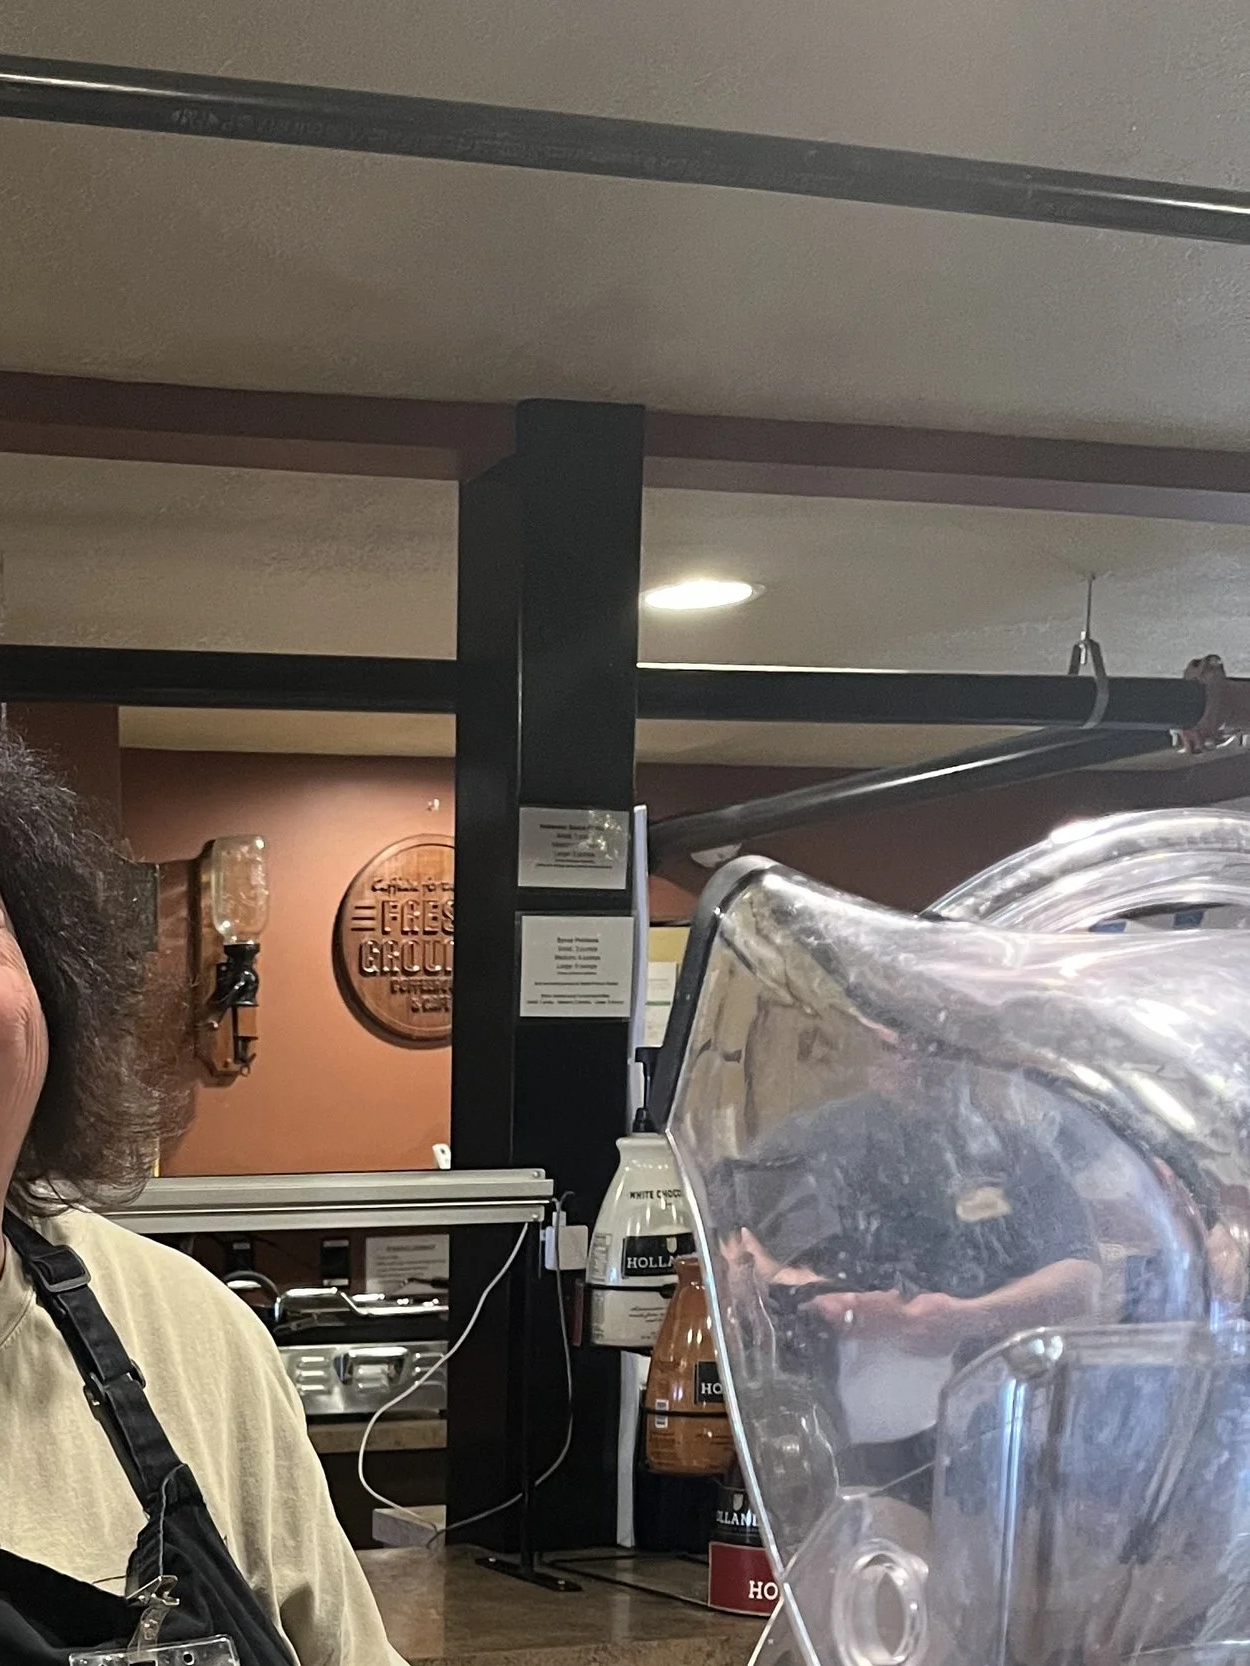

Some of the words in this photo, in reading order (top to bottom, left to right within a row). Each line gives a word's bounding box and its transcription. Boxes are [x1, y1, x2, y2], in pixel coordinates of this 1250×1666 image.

[381, 899, 455, 935] FRES
[358, 939, 454, 977] GROU
[630, 1190, 654, 1199] WHITE
[657, 1189, 682, 1199] CHOCO
[627, 1255, 674, 1269] HOLLA
[701, 1382, 723, 1395] HO
[748, 1580, 778, 1600] HO
